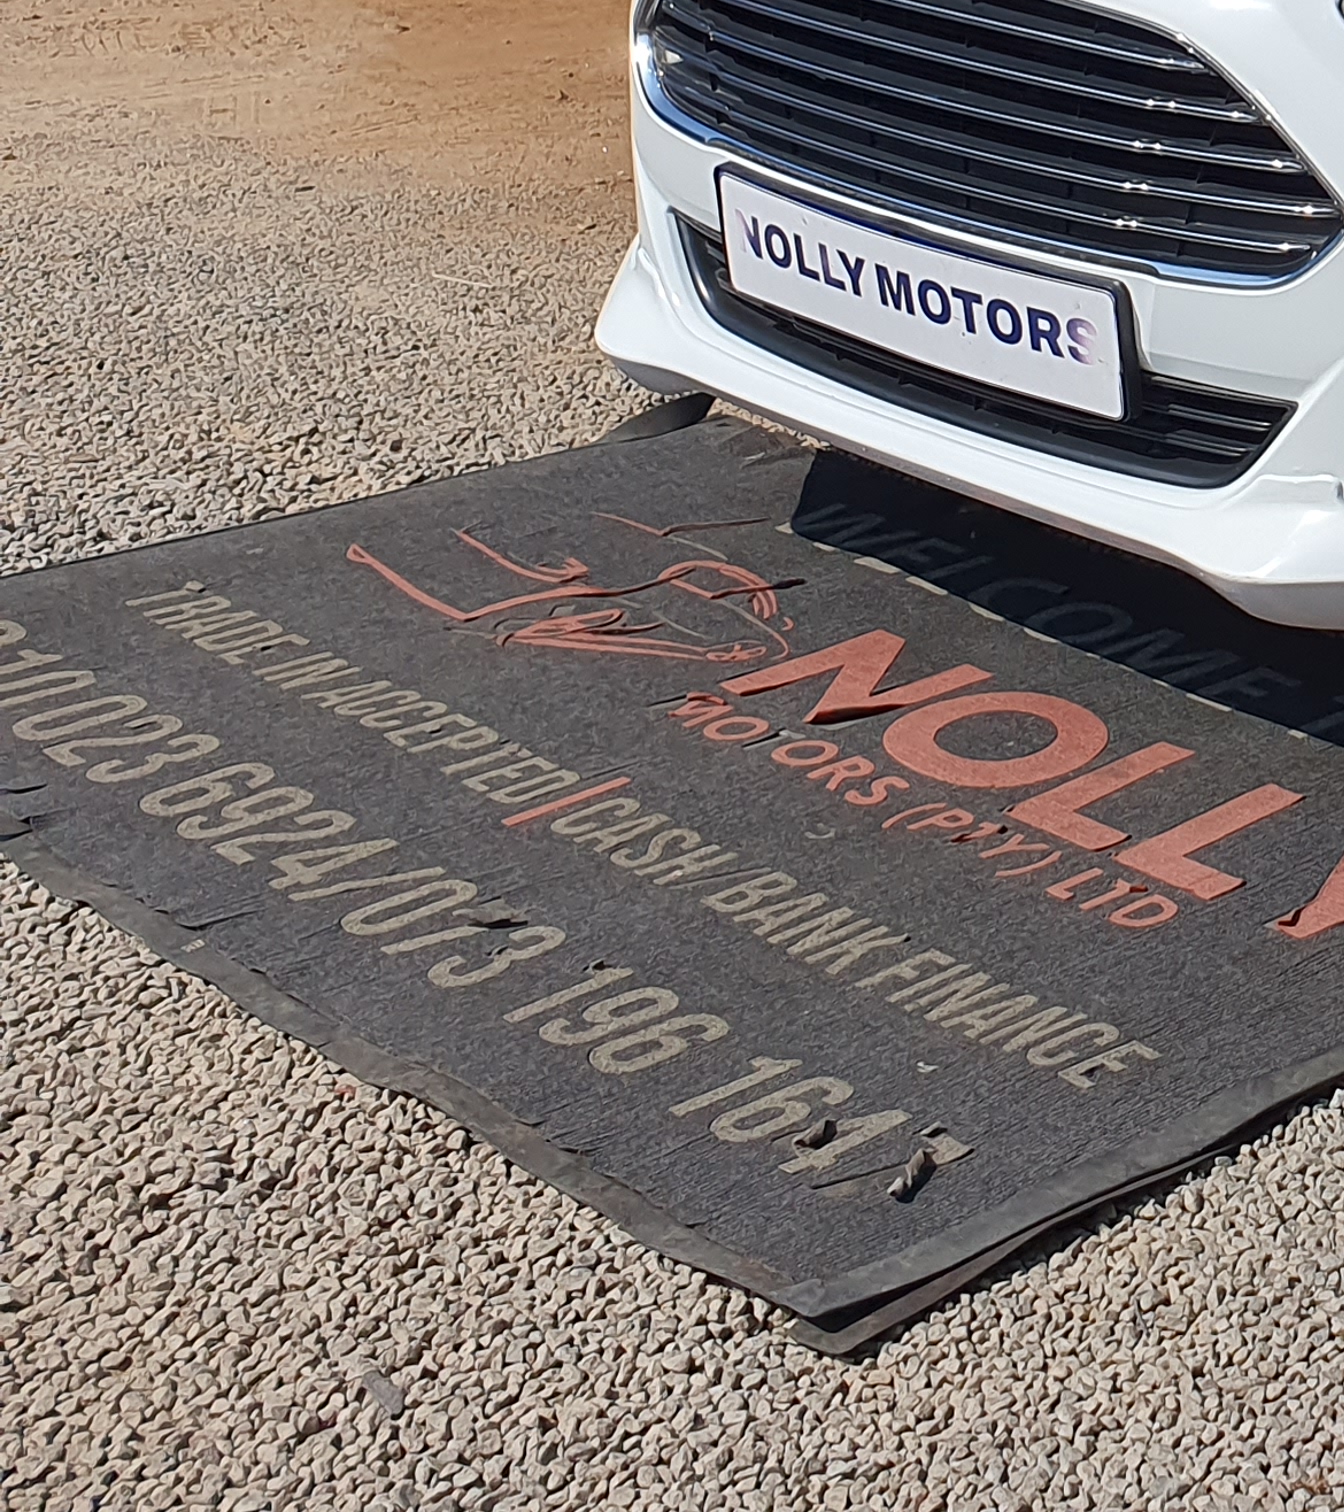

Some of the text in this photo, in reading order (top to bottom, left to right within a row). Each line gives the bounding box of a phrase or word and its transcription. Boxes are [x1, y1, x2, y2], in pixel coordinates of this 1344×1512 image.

[735, 208, 1098, 366] NOLLY MOTORS
[775, 501, 1302, 712] WELCOME
[125, 580, 310, 666] TRADE
[854, 947, 1163, 1090] FINANCE
[1046, 867, 1180, 928] LTD
[502, 960, 730, 1075] 196
